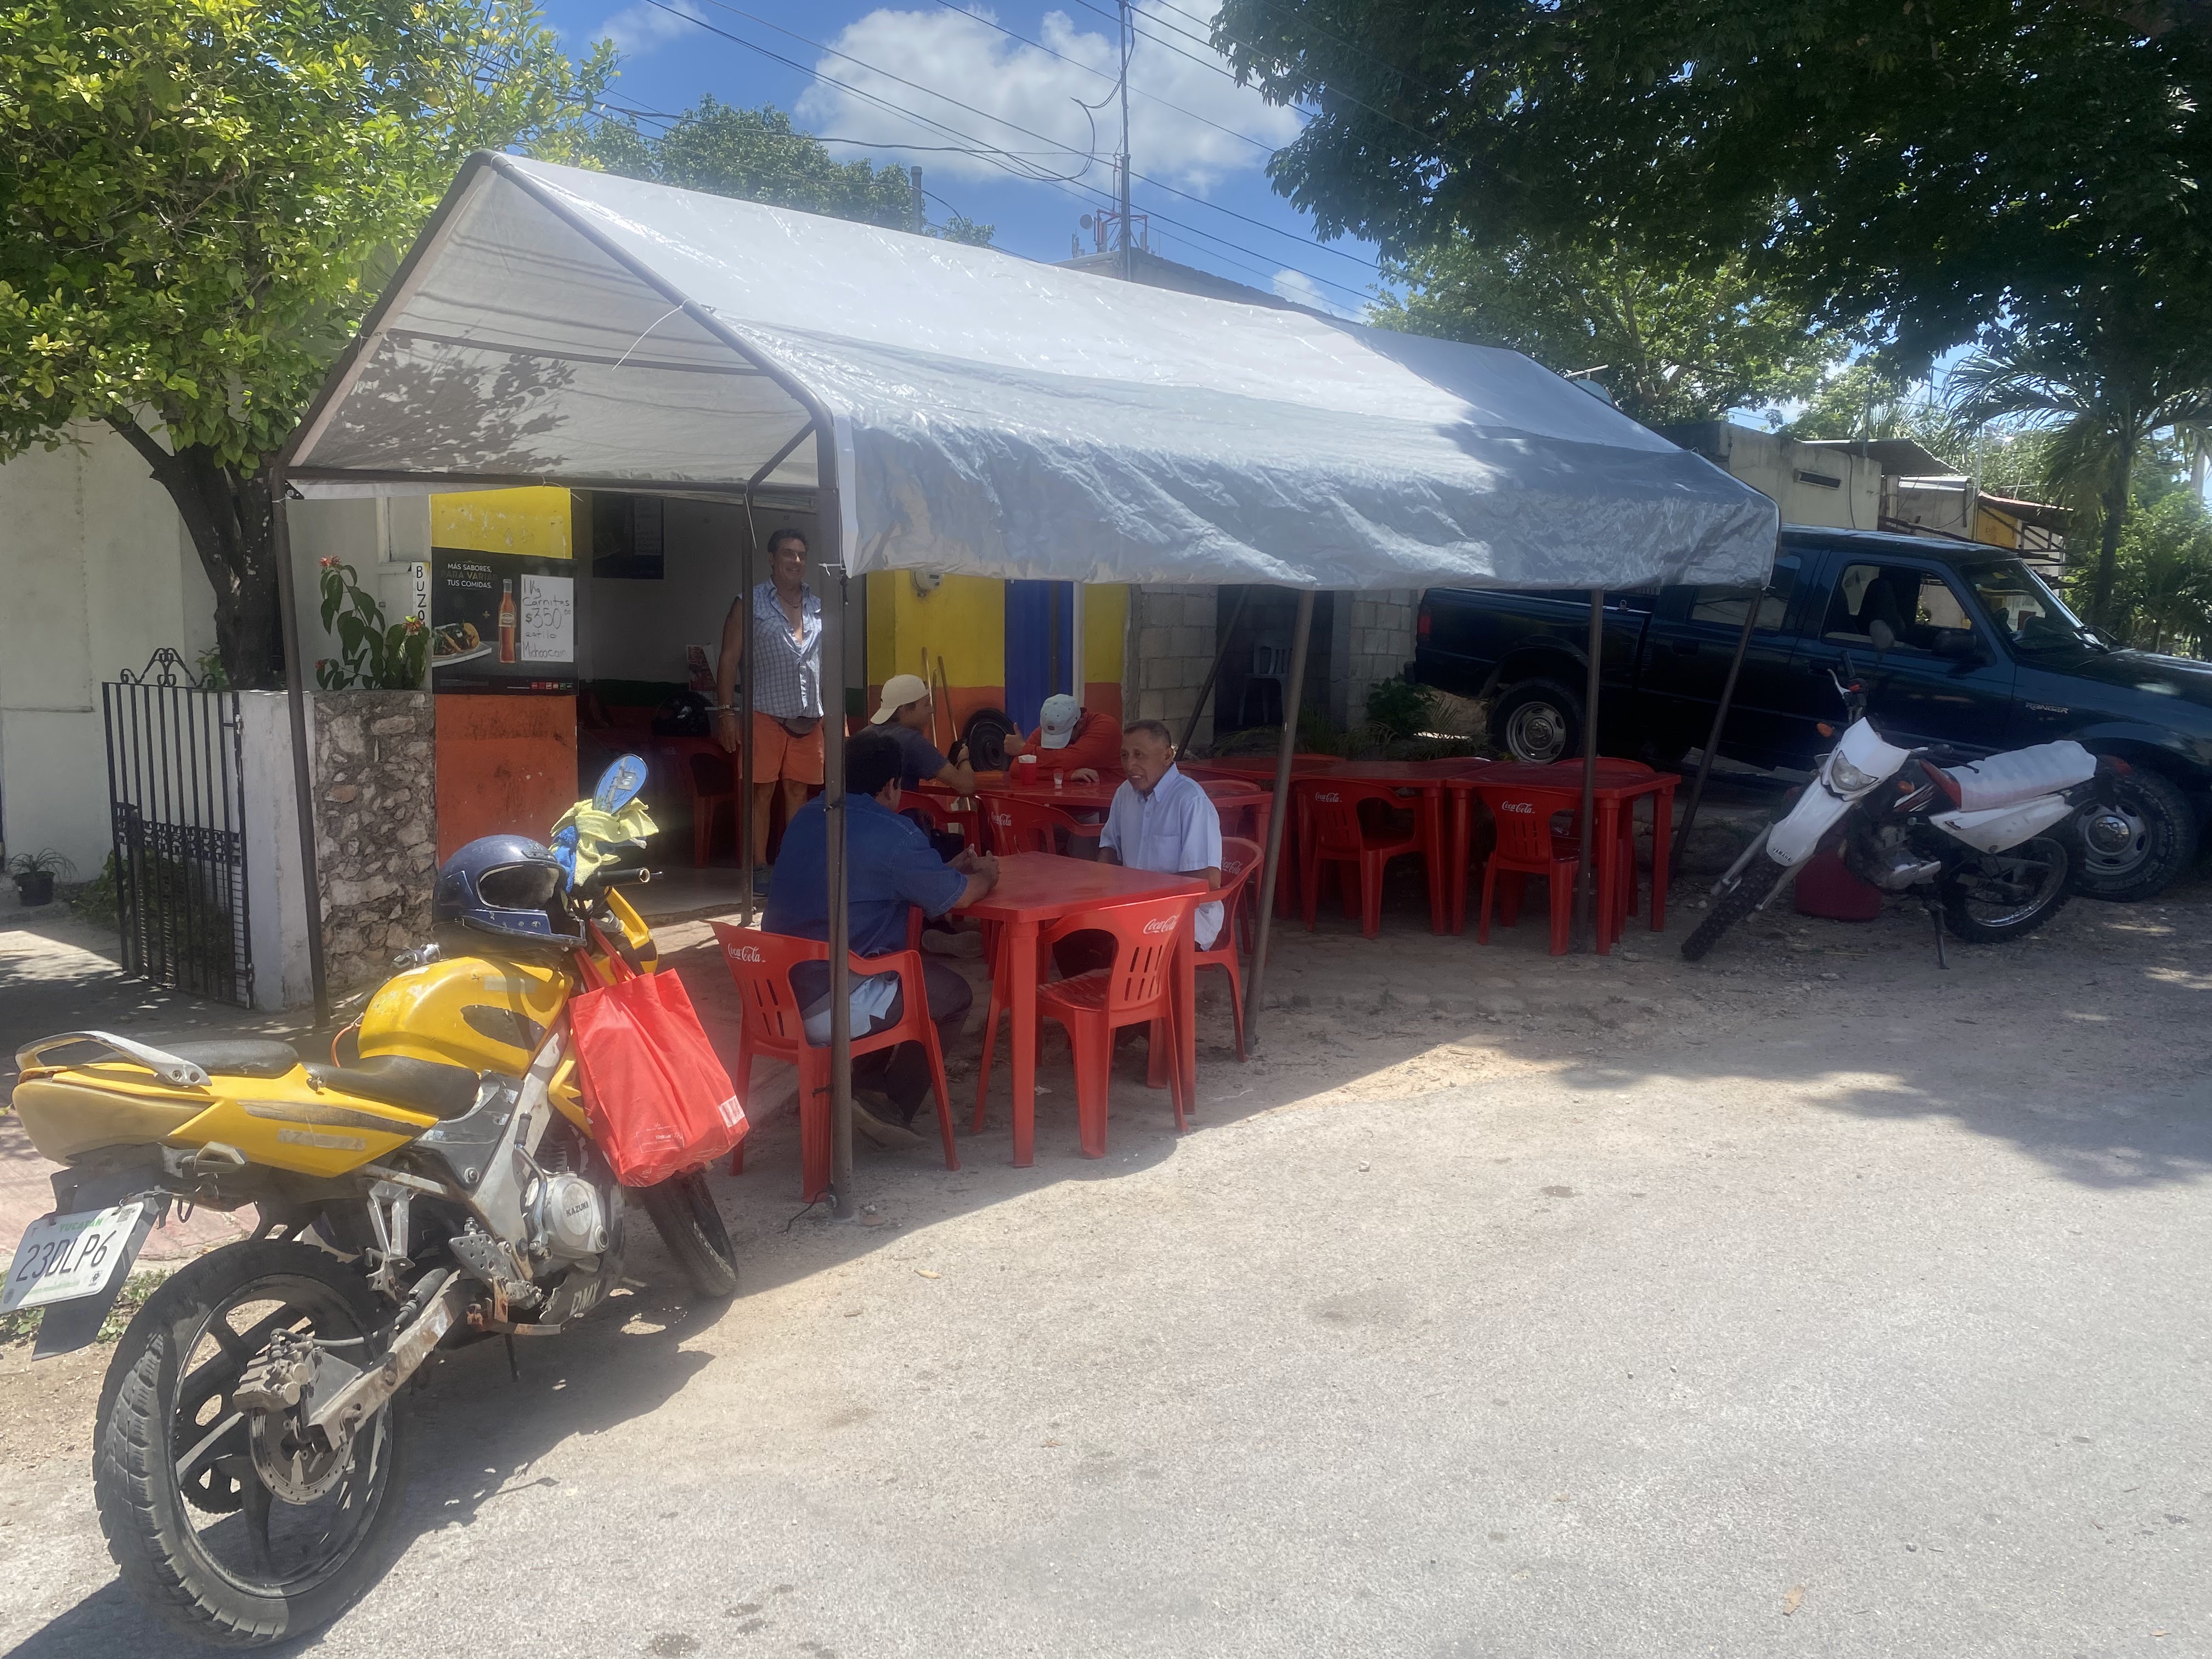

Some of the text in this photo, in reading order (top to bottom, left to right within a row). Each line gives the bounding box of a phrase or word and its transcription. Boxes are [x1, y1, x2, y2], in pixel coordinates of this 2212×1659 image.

[462, 563, 492, 573] SABORES,
[461, 580, 493, 589] COMIDAS.
[416, 566, 426, 626] BUZO
[522, 595, 570, 606] Carnitas
[2025, 702, 2069, 714] RANGER
[566, 1201, 589, 1217] KAZUKI
